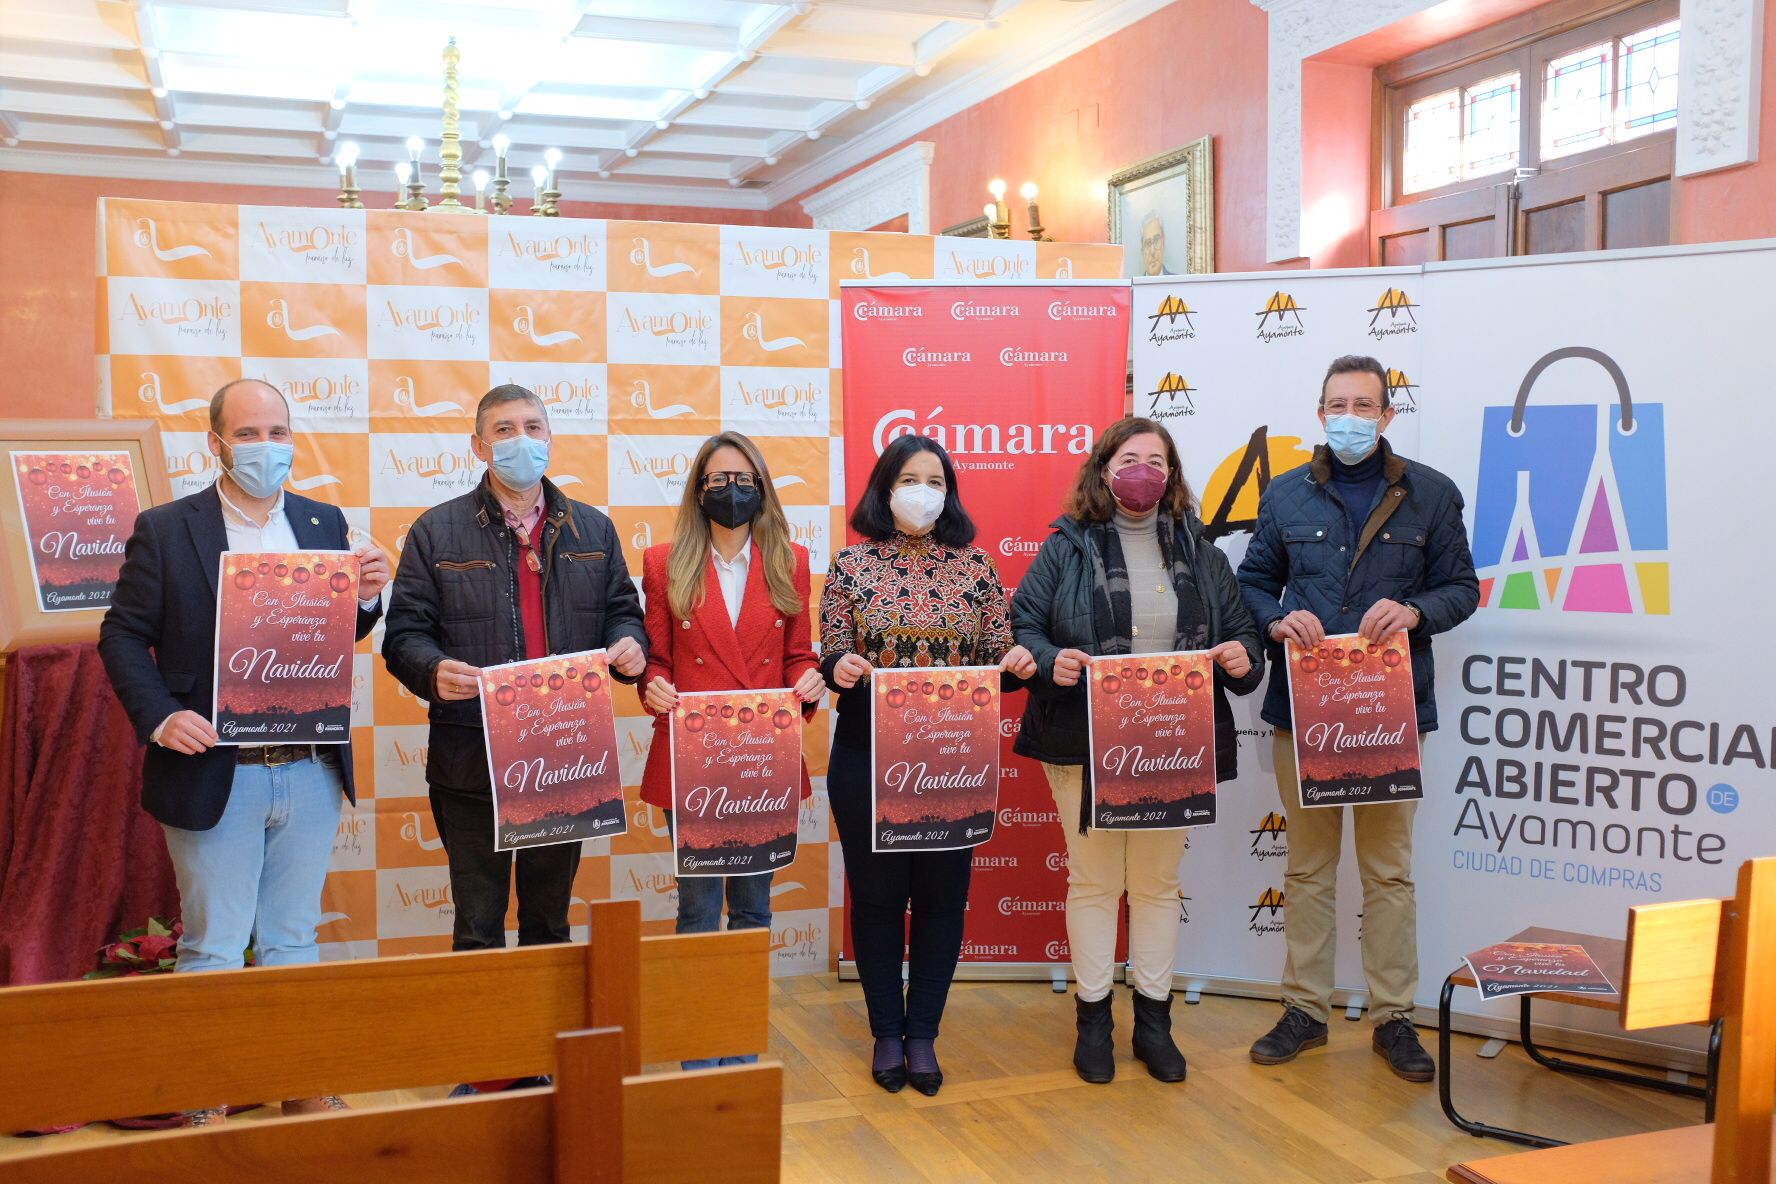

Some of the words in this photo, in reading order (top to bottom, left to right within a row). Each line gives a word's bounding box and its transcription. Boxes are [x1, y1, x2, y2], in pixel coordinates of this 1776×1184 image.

[1149, 330, 1196, 347] Ayamonte
[1256, 327, 1304, 344] Ayamonte
[1368, 324, 1418, 340] Ayamonte
[1149, 406, 1196, 424] Ayamonte
[952, 459, 1016, 474] Ayamonte
[48, 486, 70, 500] Con
[72, 484, 112, 500] Ilusión
[52, 505, 59, 516] y
[63, 500, 113, 516] Esperanza
[87, 515, 102, 526] vive
[106, 514, 116, 525] tu
[46, 591, 86, 606] Ayamonte
[88, 590, 110, 600] 2021
[252, 590, 279, 608] Con
[282, 591, 330, 608] Ilusión
[250, 616, 262, 628] y
[266, 608, 327, 630] Esperanza
[292, 630, 310, 642] vive
[313, 630, 326, 642] tu
[228, 646, 344, 684] Navidad
[1318, 672, 1342, 688] Con
[1343, 670, 1386, 687] Ilusión
[1462, 654, 1686, 708] CENTRO
[1119, 693, 1142, 709] Con
[1144, 692, 1188, 709] Ilusión
[1318, 694, 1329, 707] y
[1332, 686, 1386, 704] Esperanza
[516, 704, 540, 720] Con
[542, 698, 586, 717] Ilusión
[904, 708, 928, 724] Con
[930, 707, 974, 724] Ilusión
[1355, 704, 1372, 714] vive
[1375, 702, 1387, 713] tu
[1118, 716, 1129, 729] y
[1132, 708, 1186, 726] Esperanza
[222, 720, 268, 738] Ayamonte
[269, 723, 297, 733] 2021
[518, 728, 528, 743] y
[530, 718, 586, 736] Esperanza
[902, 732, 912, 744] y
[916, 725, 972, 743] Esperanza
[1154, 726, 1172, 738] vive
[1174, 725, 1186, 736] tu
[1304, 722, 1406, 753] Navidad
[1460, 705, 1776, 770] COMERCIA
[556, 734, 574, 748] vive
[576, 731, 588, 744] tu
[702, 732, 726, 748] Con
[730, 730, 775, 748] Ilusión
[940, 744, 957, 754] vive
[960, 742, 972, 754] tu
[703, 756, 714, 768] y
[716, 748, 774, 767] Esperanza
[1102, 745, 1206, 777] Navidad
[504, 750, 608, 793] Navidad
[740, 768, 759, 779] vive
[762, 766, 774, 778] tu
[884, 762, 990, 794] Navidad
[1306, 786, 1346, 801] Ayamonte
[1348, 786, 1372, 796] 2021
[1454, 756, 1698, 816] ABIERTO
[1711, 790, 1736, 806] DE
[684, 786, 792, 820] Navidad
[1100, 811, 1140, 825] Ayamonte
[1142, 811, 1167, 821] 2021
[504, 830, 547, 845] Ayamonte
[549, 824, 574, 836] 2021
[881, 830, 923, 844] Ayamonte
[924, 830, 950, 840] 2021
[1454, 798, 1726, 865] Ayamonte
[684, 855, 726, 870] Ayamonte
[728, 855, 753, 866] 2021
[1250, 847, 1288, 862] Ayamon
[1453, 850, 1523, 875] CIUDAD
[1530, 858, 1556, 880] DE
[1563, 862, 1663, 892] COMPRAS
[1249, 922, 1284, 936] Ayamon
[1482, 964, 1590, 977] Navidad
